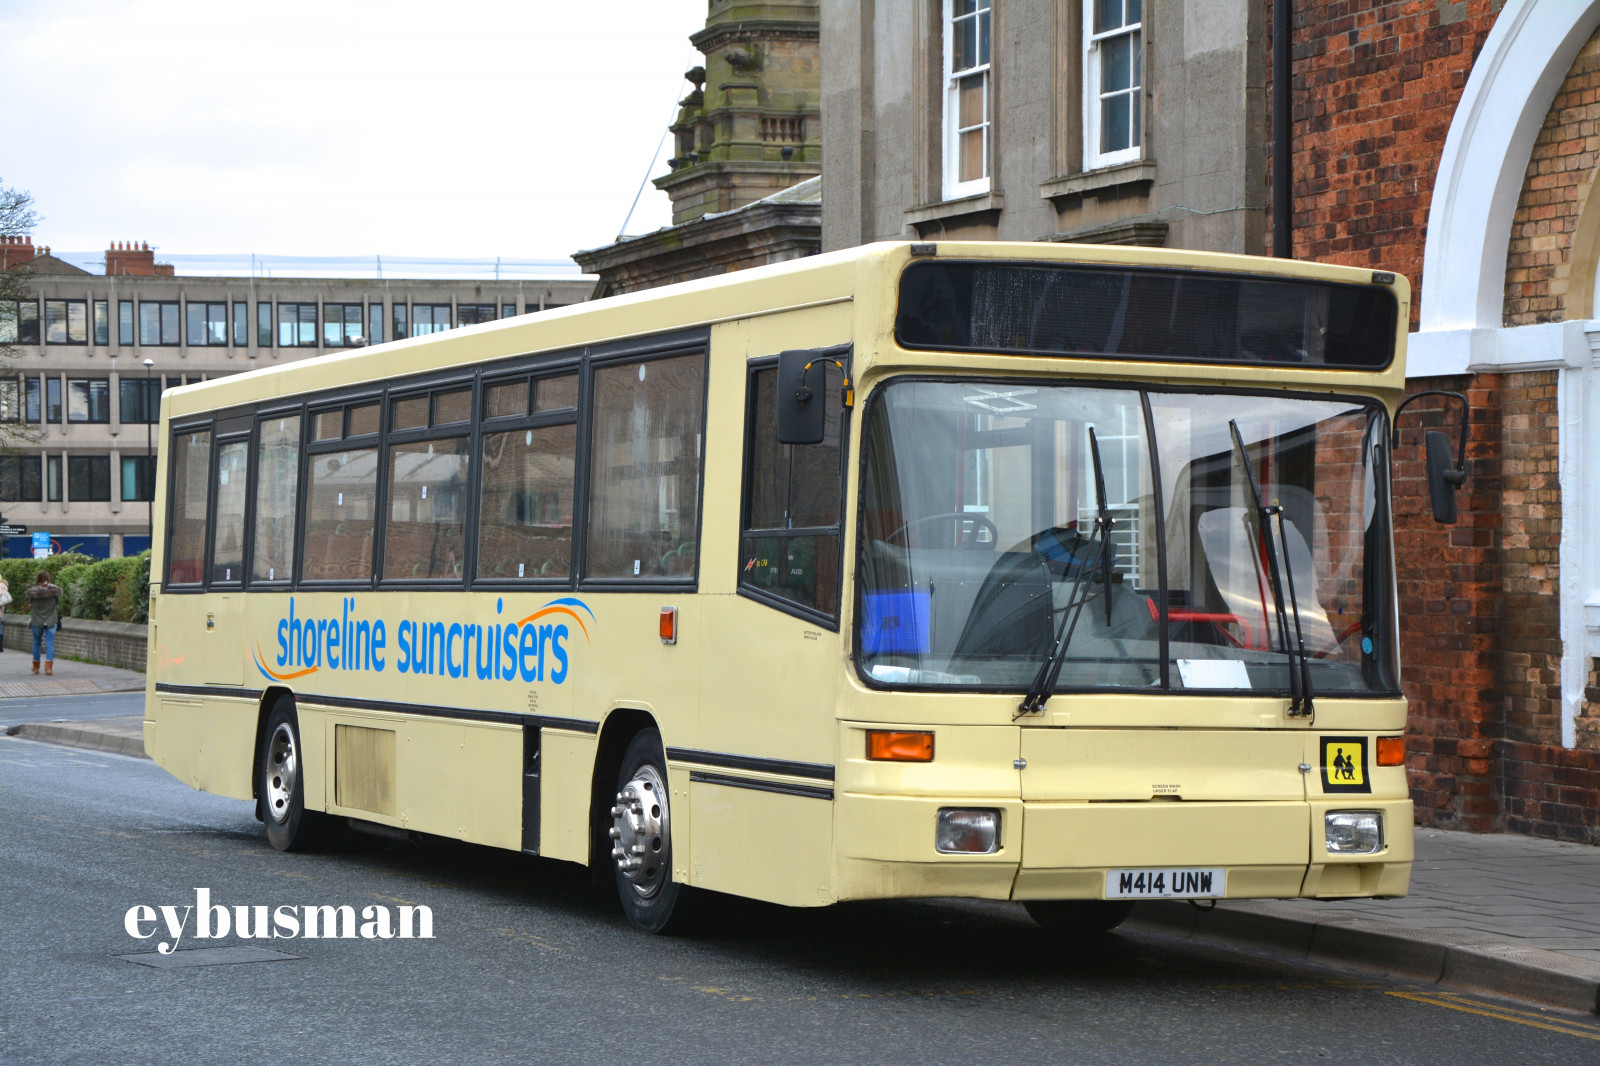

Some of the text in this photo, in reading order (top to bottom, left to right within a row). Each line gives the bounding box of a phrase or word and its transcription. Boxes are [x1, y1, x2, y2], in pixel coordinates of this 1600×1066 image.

[276, 596, 569, 685] shoreline suncruisers
[1119, 872, 1212, 894] M414 UNW
